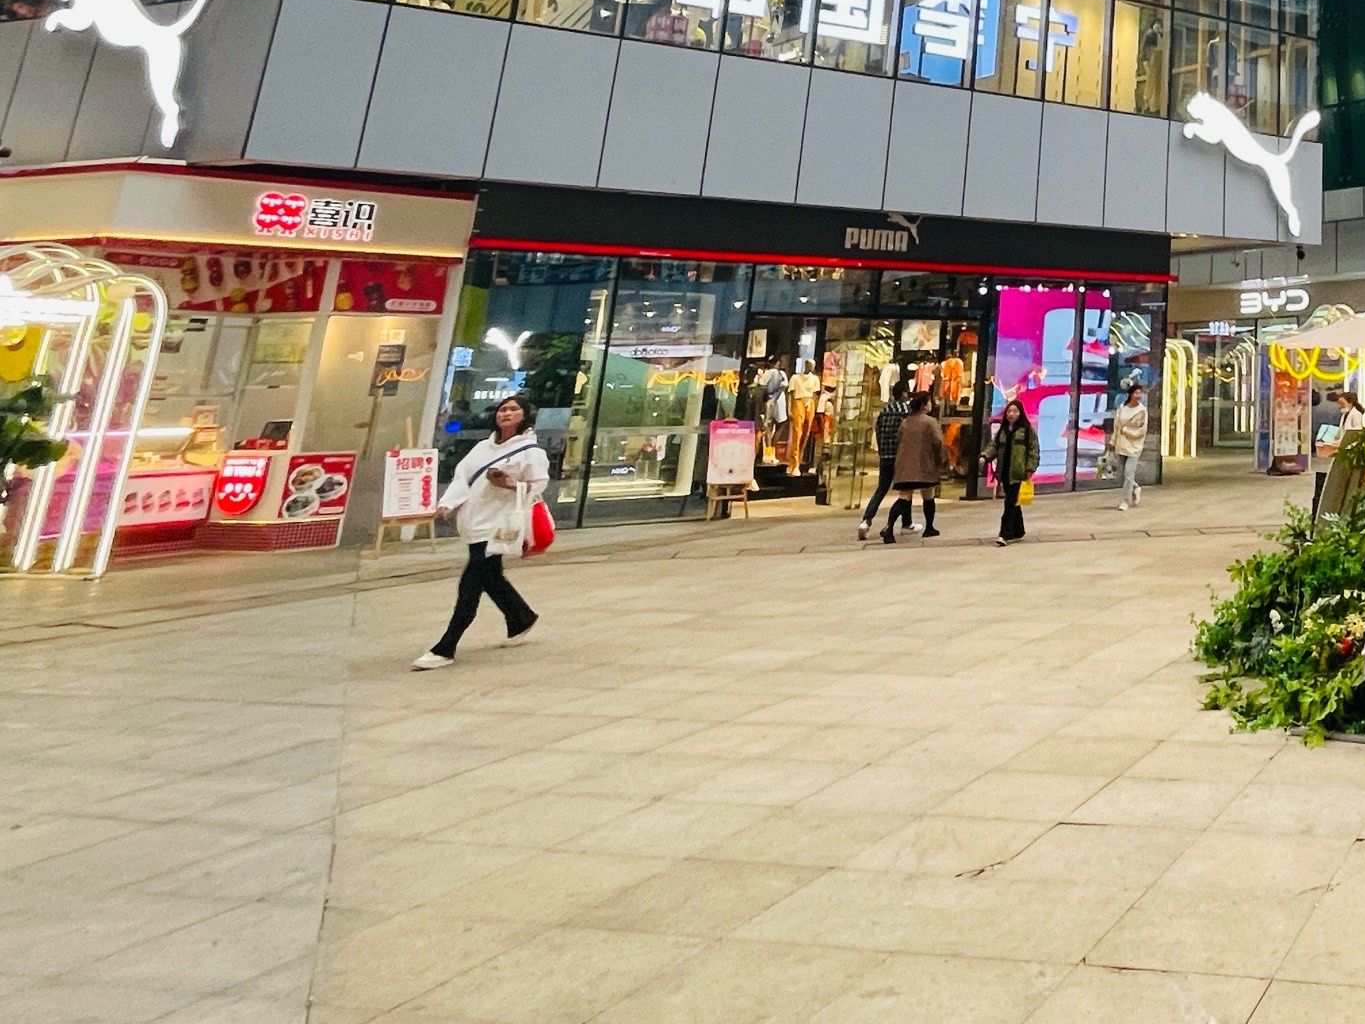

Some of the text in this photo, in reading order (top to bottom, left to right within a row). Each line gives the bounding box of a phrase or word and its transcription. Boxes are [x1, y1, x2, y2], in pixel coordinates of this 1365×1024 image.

[308, 198, 378, 231] 喜识
[303, 227, 373, 242] XISHI
[844, 227, 908, 252] PUMA
[1240, 288, 1310, 314] BYD
